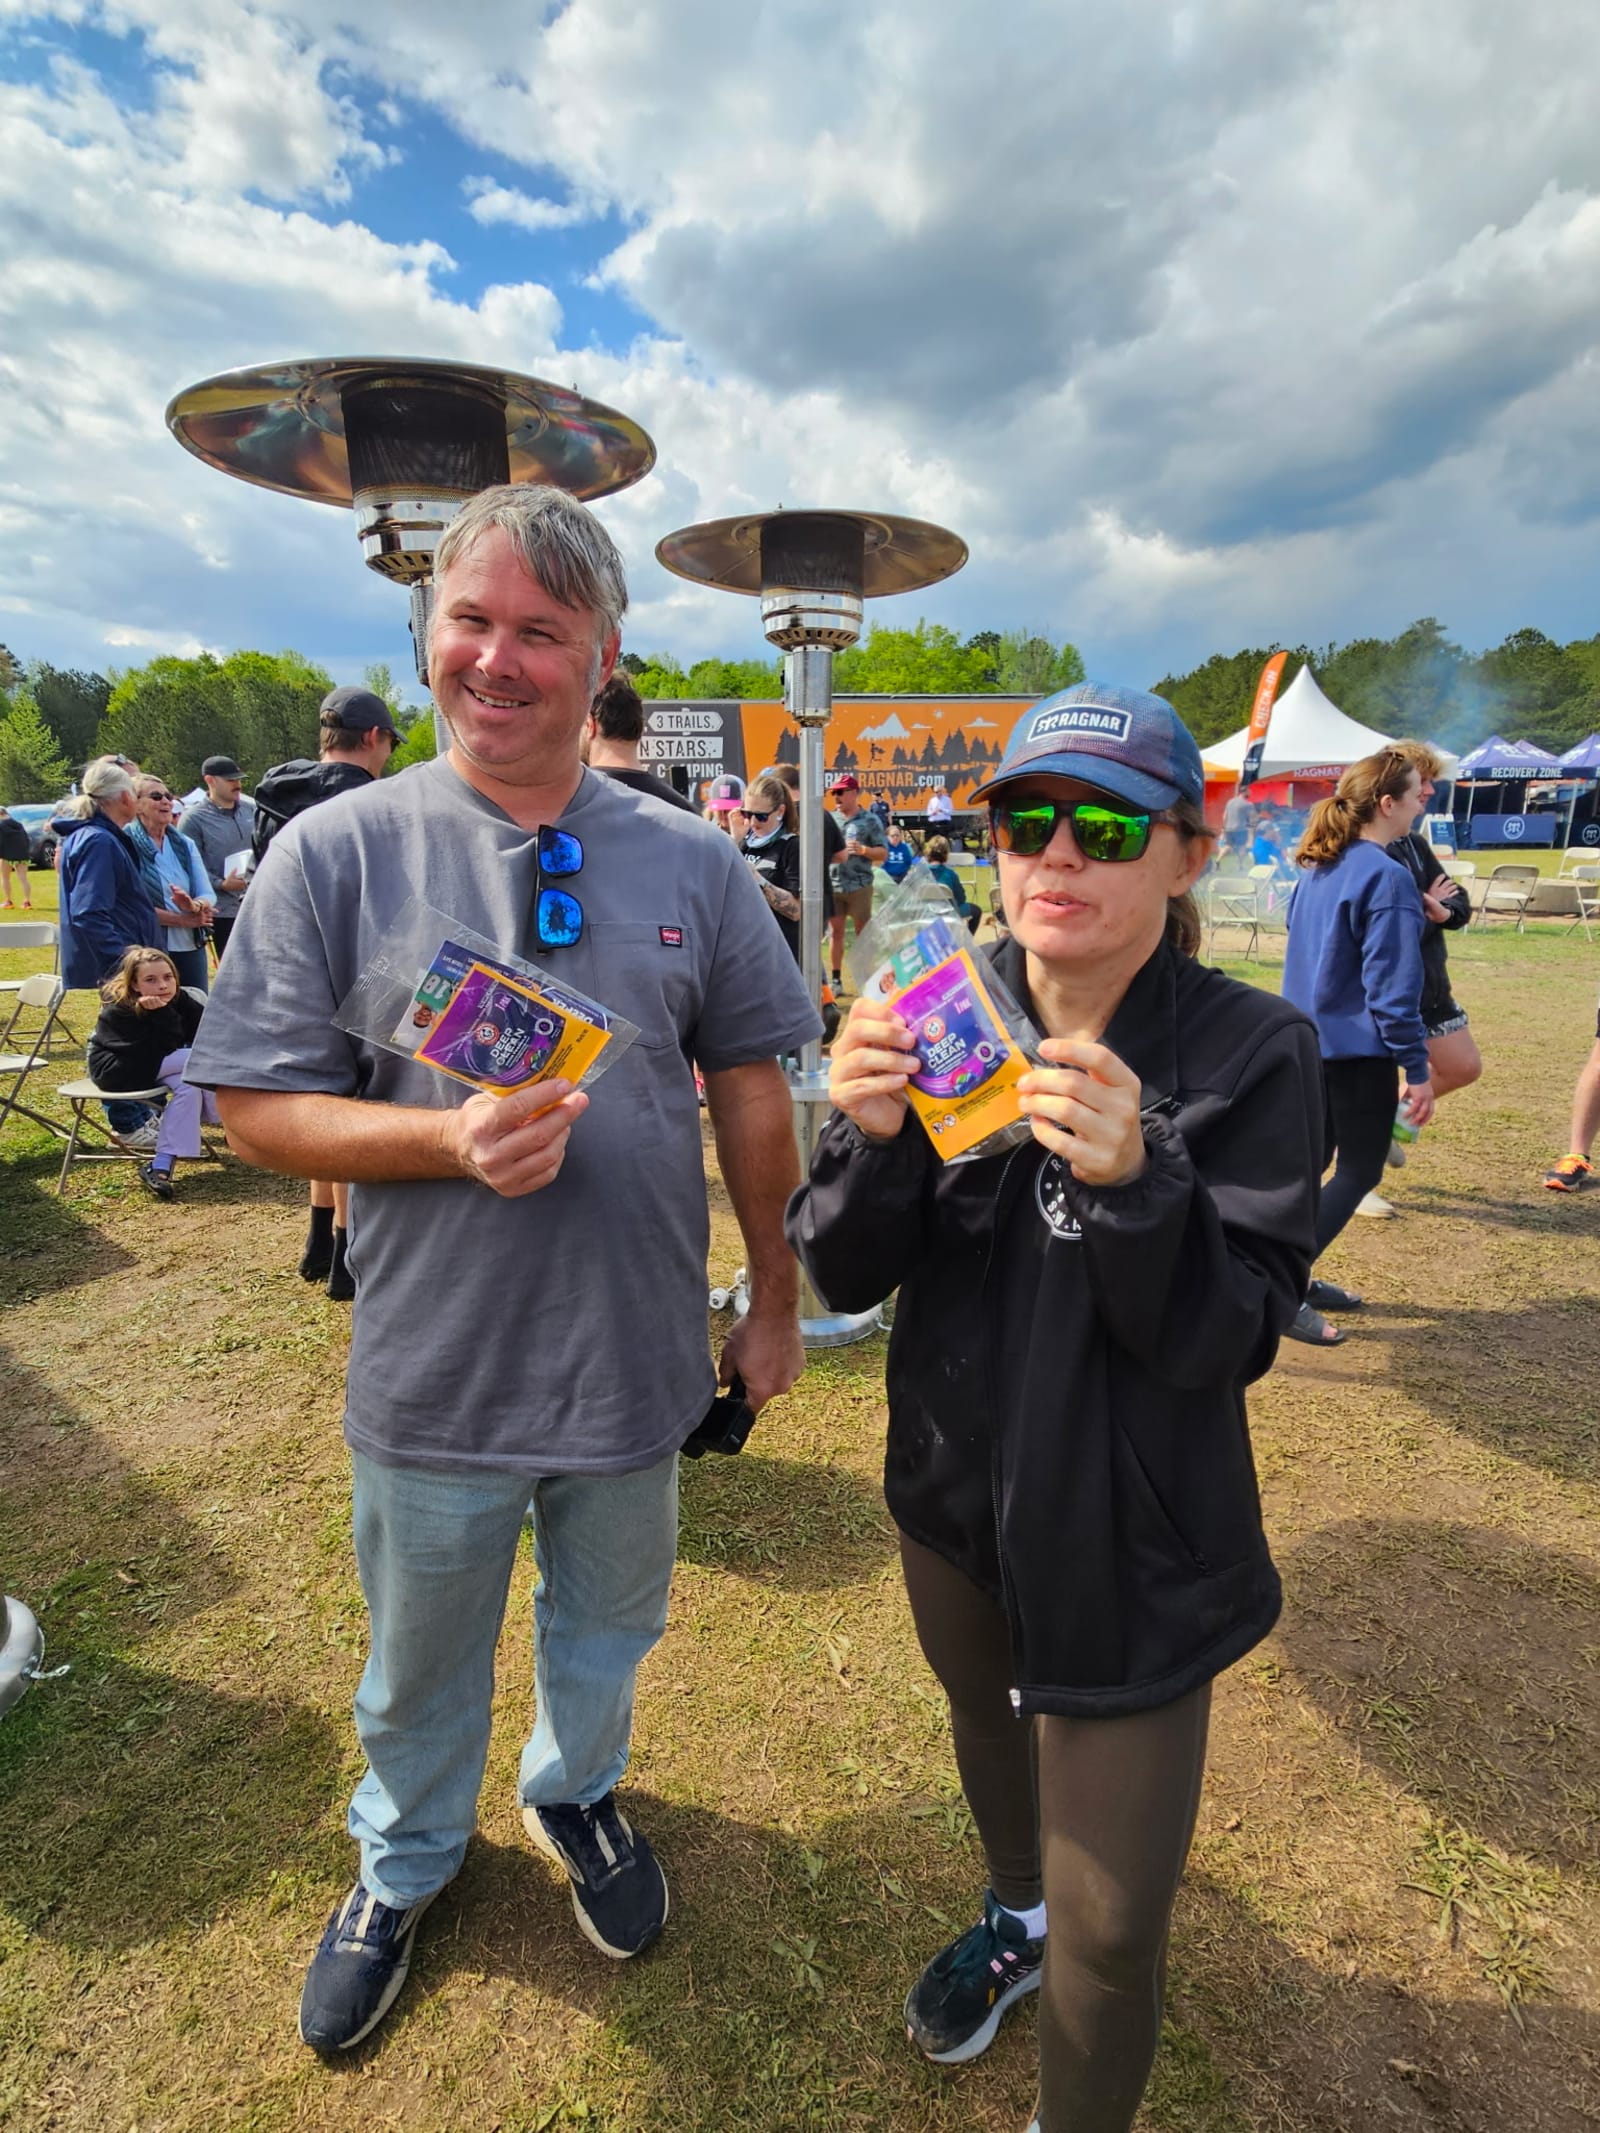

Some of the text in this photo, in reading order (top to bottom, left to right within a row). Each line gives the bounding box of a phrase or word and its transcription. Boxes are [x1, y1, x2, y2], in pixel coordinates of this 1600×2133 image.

[656, 715, 664, 728] 3
[1058, 712, 1122, 731] RAGNAR
[656, 763, 724, 778] CPING
[1294, 767, 1342, 778] RAGNAR
[1491, 767, 1563, 778] RECOVERY ZONE
[422, 974, 451, 999] 18
[489, 1027, 513, 1058] DEEP
[496, 1027, 526, 1066] CLEAN
[927, 1032, 957, 1058] DEEP
[928, 1038, 967, 1069] CLEAN
